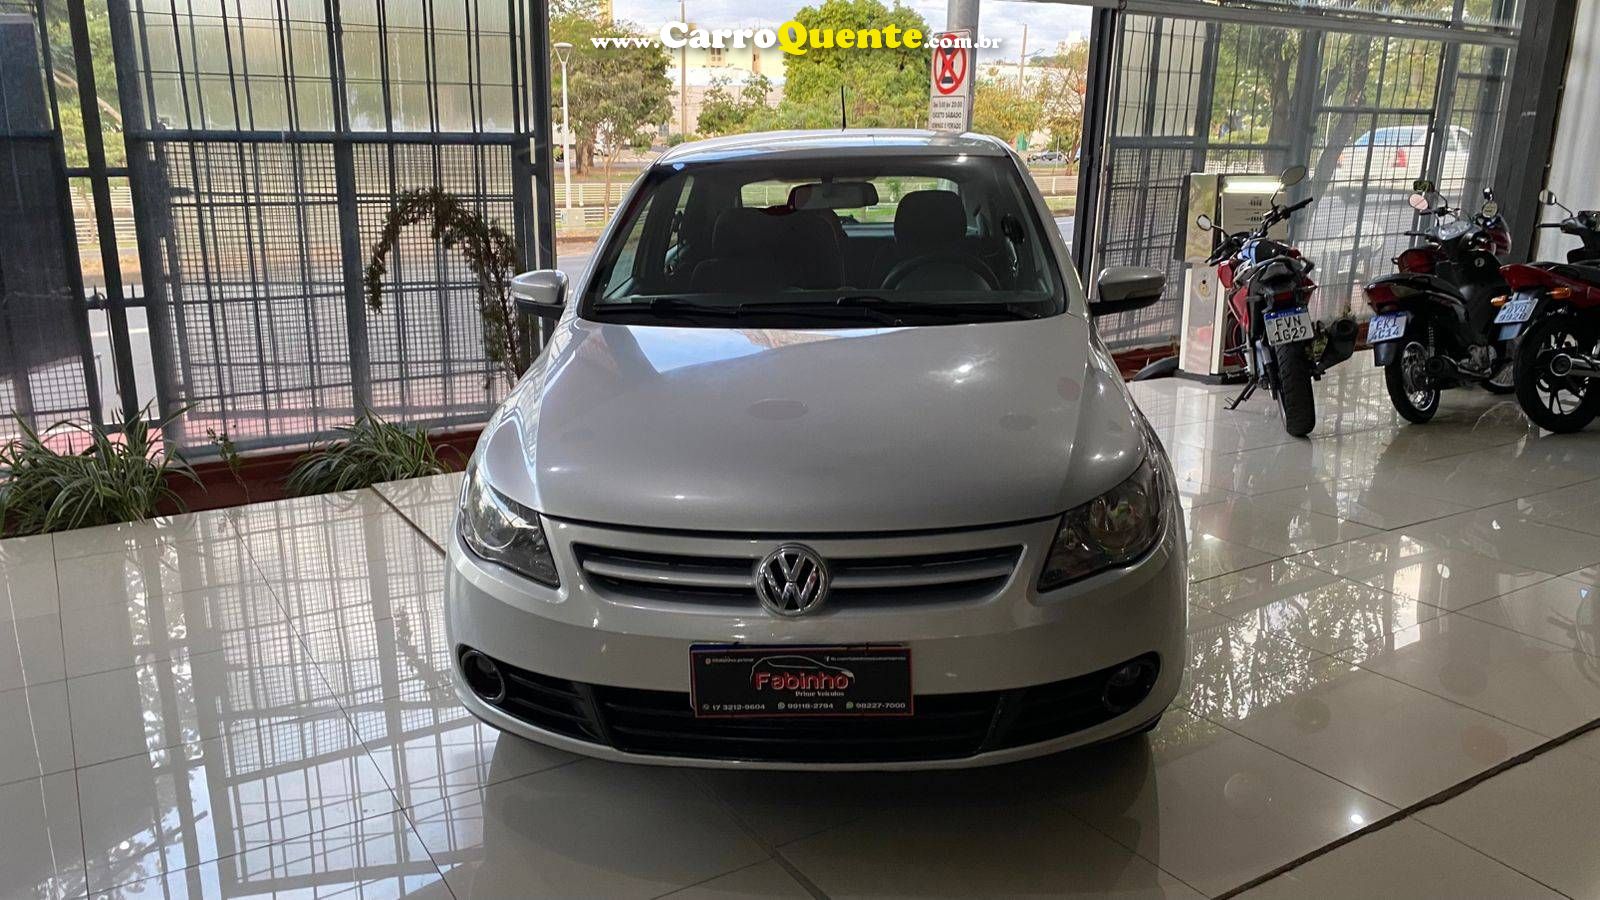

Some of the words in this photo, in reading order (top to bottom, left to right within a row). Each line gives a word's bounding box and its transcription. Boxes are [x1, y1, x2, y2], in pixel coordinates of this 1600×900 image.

[1275, 315, 1301, 330] FVN
[1274, 326, 1306, 342] 1G29
[755, 671, 849, 690] Fabinho
